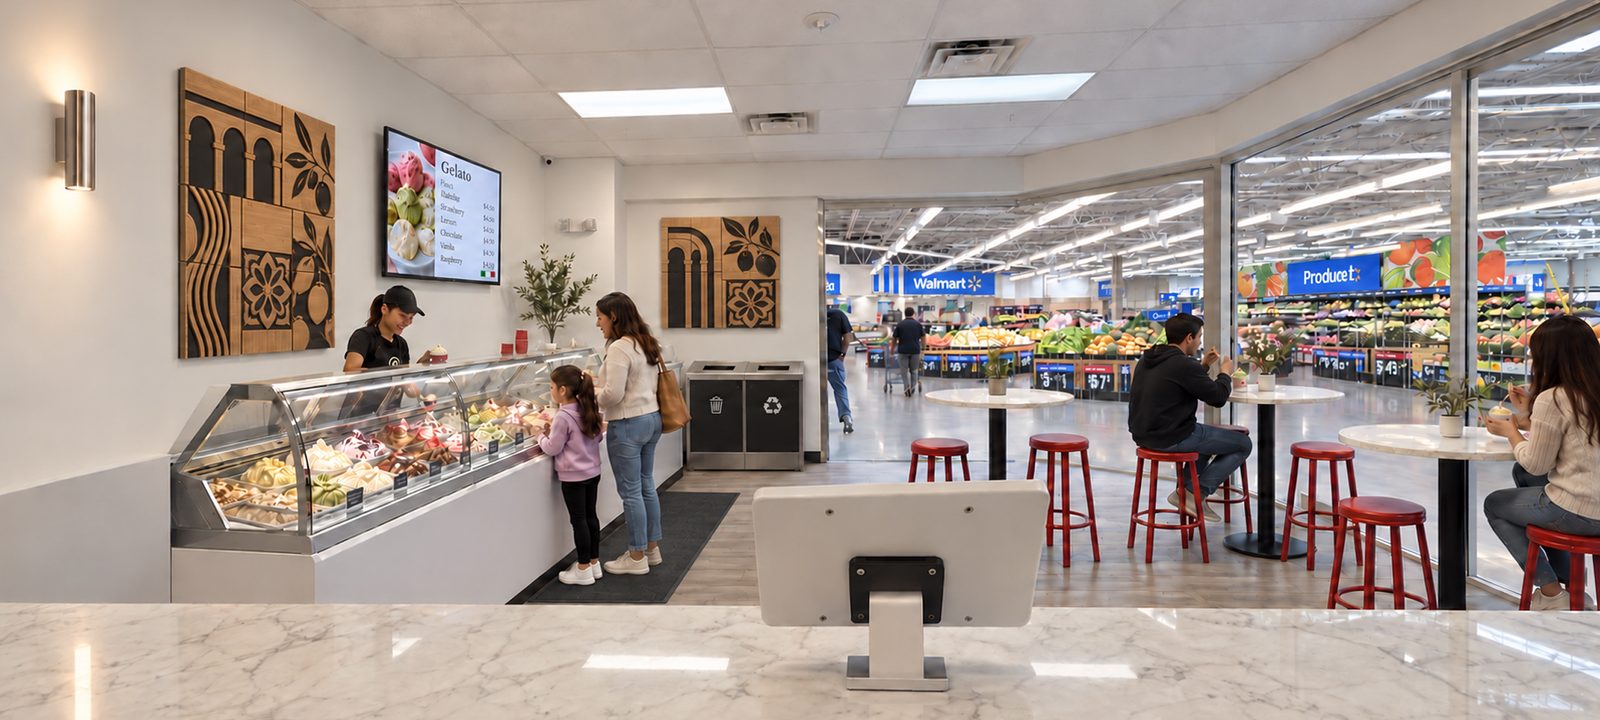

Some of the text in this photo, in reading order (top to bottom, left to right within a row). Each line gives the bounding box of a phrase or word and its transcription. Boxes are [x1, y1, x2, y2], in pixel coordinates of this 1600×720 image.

[441, 161, 471, 182] Gelato
[913, 277, 966, 290] Walmart
[1303, 268, 1348, 285] Produce
